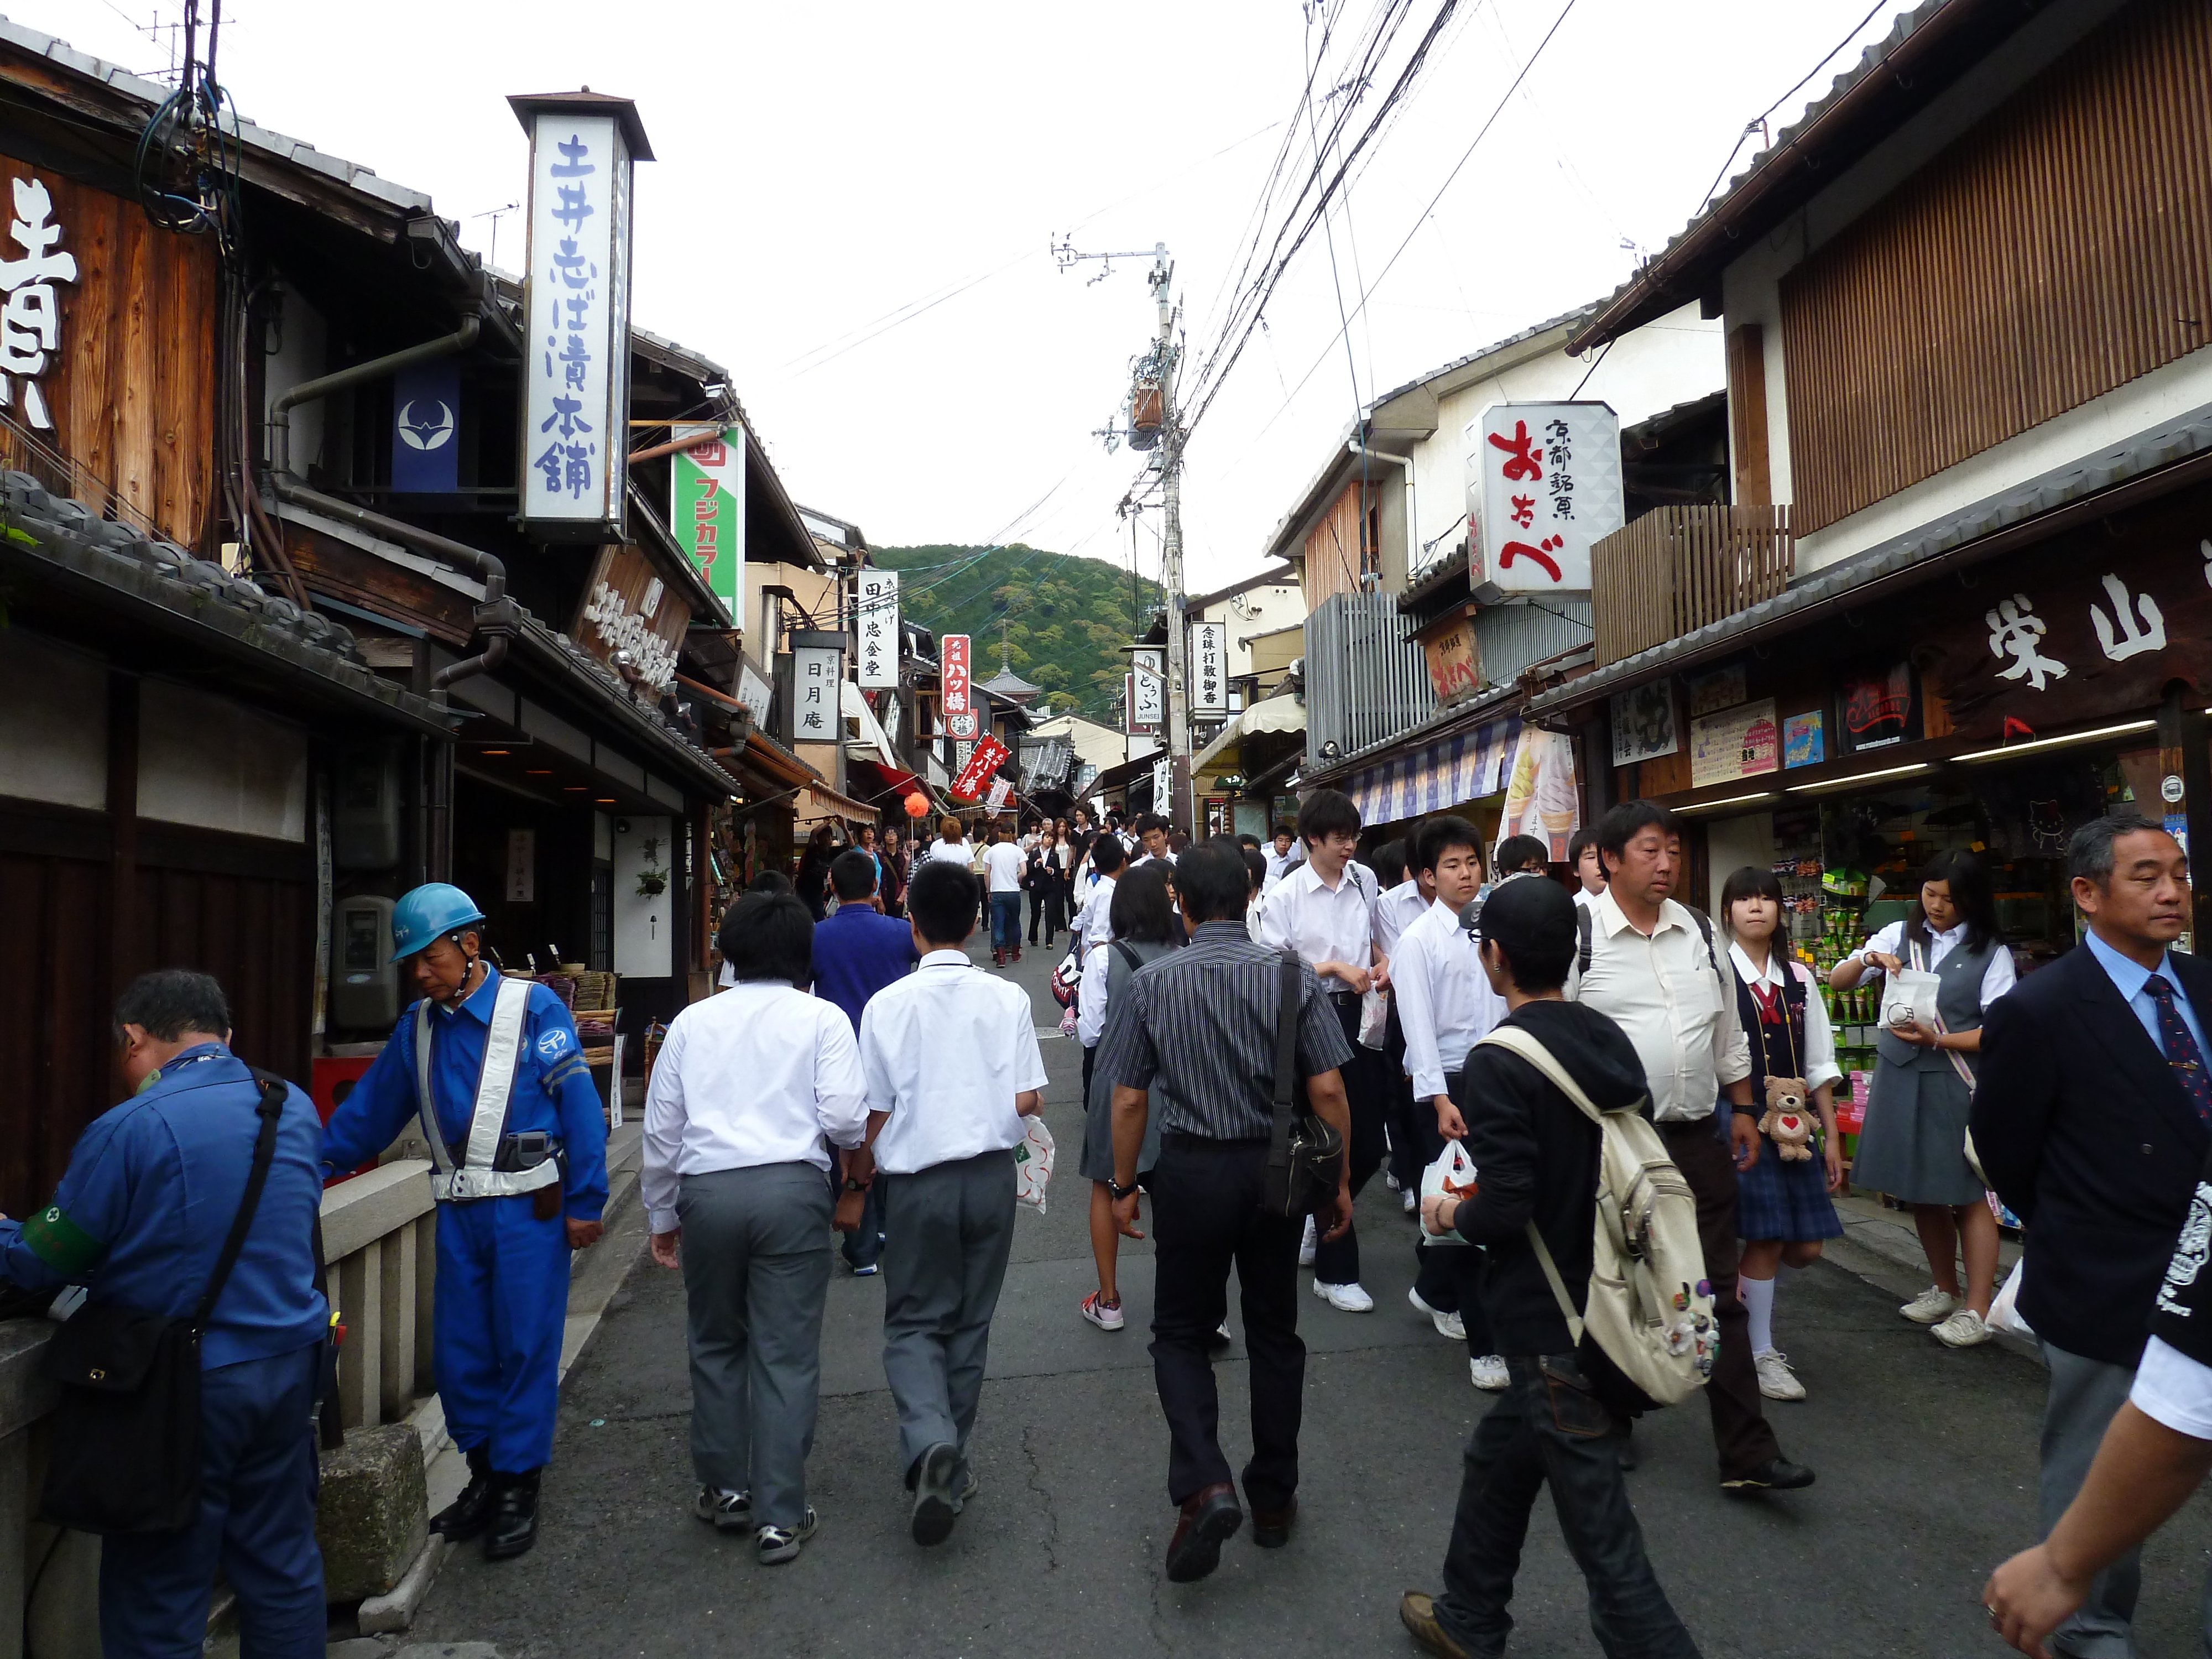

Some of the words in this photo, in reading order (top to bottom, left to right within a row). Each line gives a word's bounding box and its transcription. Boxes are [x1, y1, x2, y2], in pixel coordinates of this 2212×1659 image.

[1488, 420, 1564, 582] おたべ
[1546, 419, 1575, 521] 京都銘菓
[695, 478, 719, 586] フジカラー
[864, 582, 883, 677] 田中忠金堂
[1985, 538, 2212, 692] 栄山
[802, 662, 823, 729] 日月庵
[826, 654, 835, 688] 京料理
[1052, 971, 1070, 998] TOMMY
